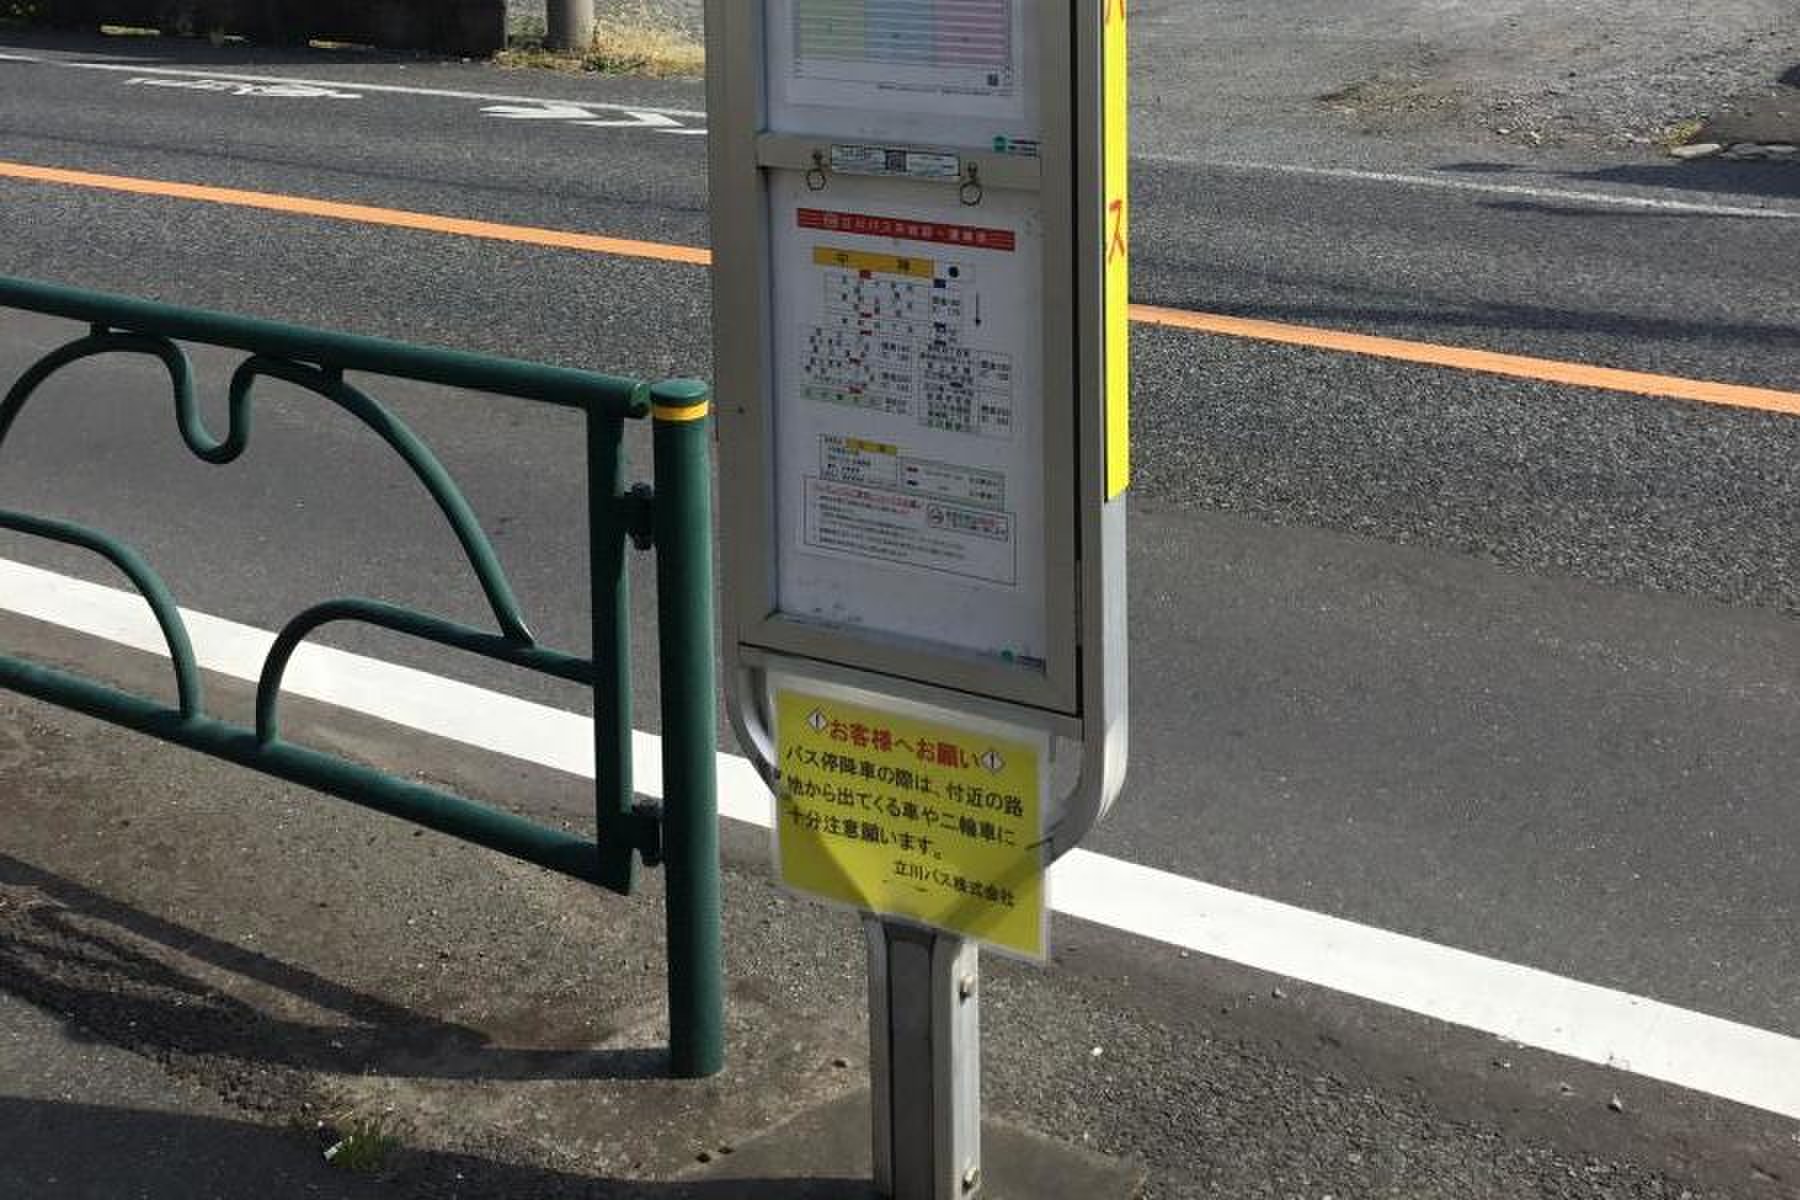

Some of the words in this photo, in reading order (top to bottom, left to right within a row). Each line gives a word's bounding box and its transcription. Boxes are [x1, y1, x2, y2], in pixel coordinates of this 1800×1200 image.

[828, 718, 981, 770] お客様へお願い
[893, 859, 1016, 908] 立川バス株式会社
